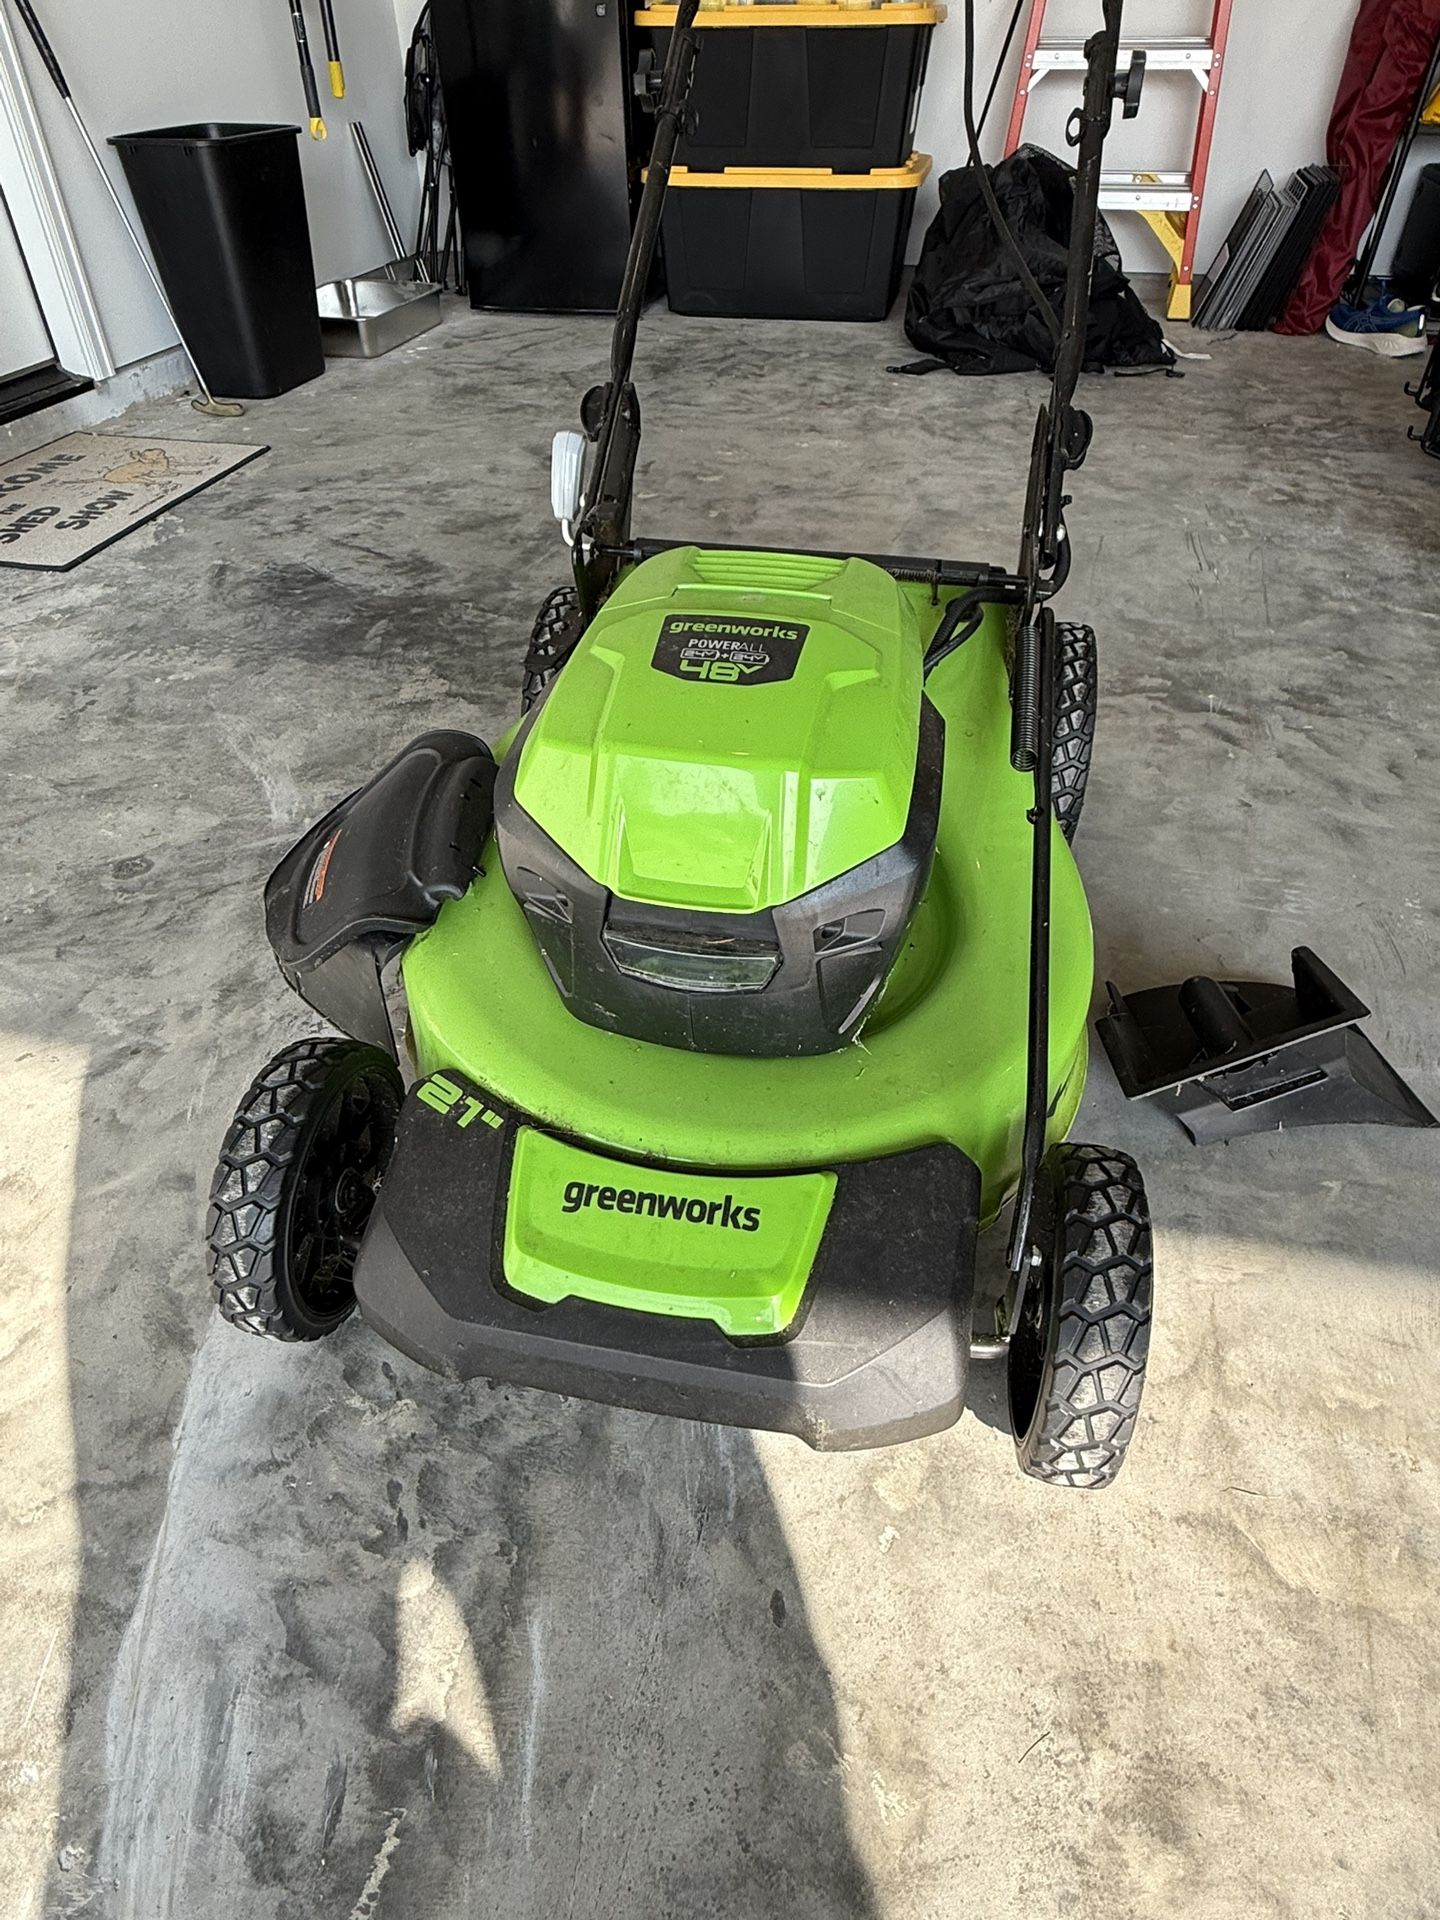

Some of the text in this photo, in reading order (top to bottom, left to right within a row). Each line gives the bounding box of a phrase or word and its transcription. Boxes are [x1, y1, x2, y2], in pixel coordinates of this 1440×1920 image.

[0, 454, 87, 498] COME
[54, 489, 134, 530] SHOW
[669, 621, 798, 640] greenworks
[688, 638, 767, 653] POWERALL
[680, 659, 763, 682] 48V
[416, 1073, 505, 1129] 21"
[561, 1181, 761, 1232] greenworks
